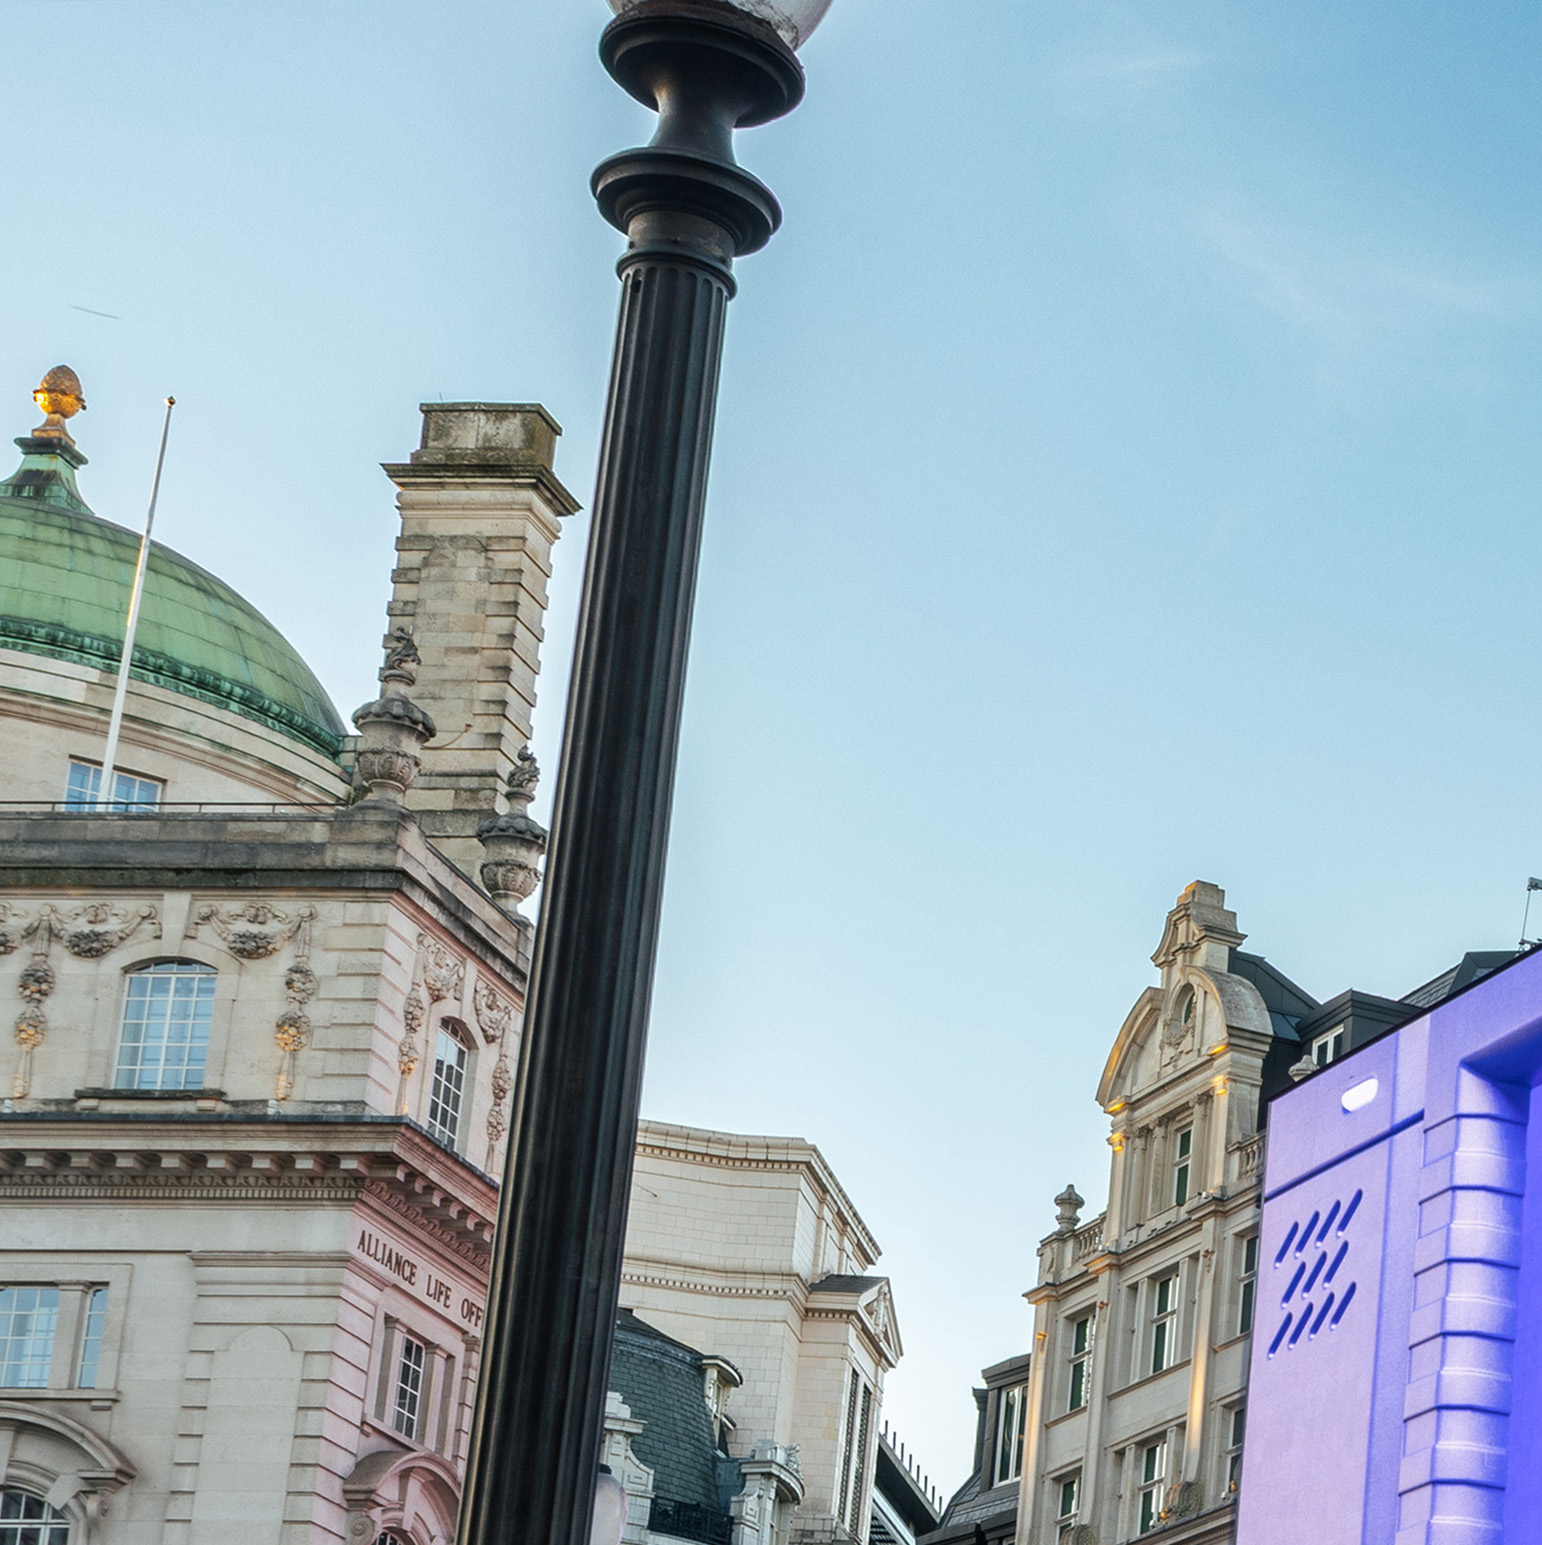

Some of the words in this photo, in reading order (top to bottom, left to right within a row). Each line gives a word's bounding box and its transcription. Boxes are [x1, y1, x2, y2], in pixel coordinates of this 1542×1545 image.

[357, 1230, 417, 1286] ALLIANCE
[426, 1274, 452, 1309] LIFE
[461, 1298, 483, 1327] OFF
